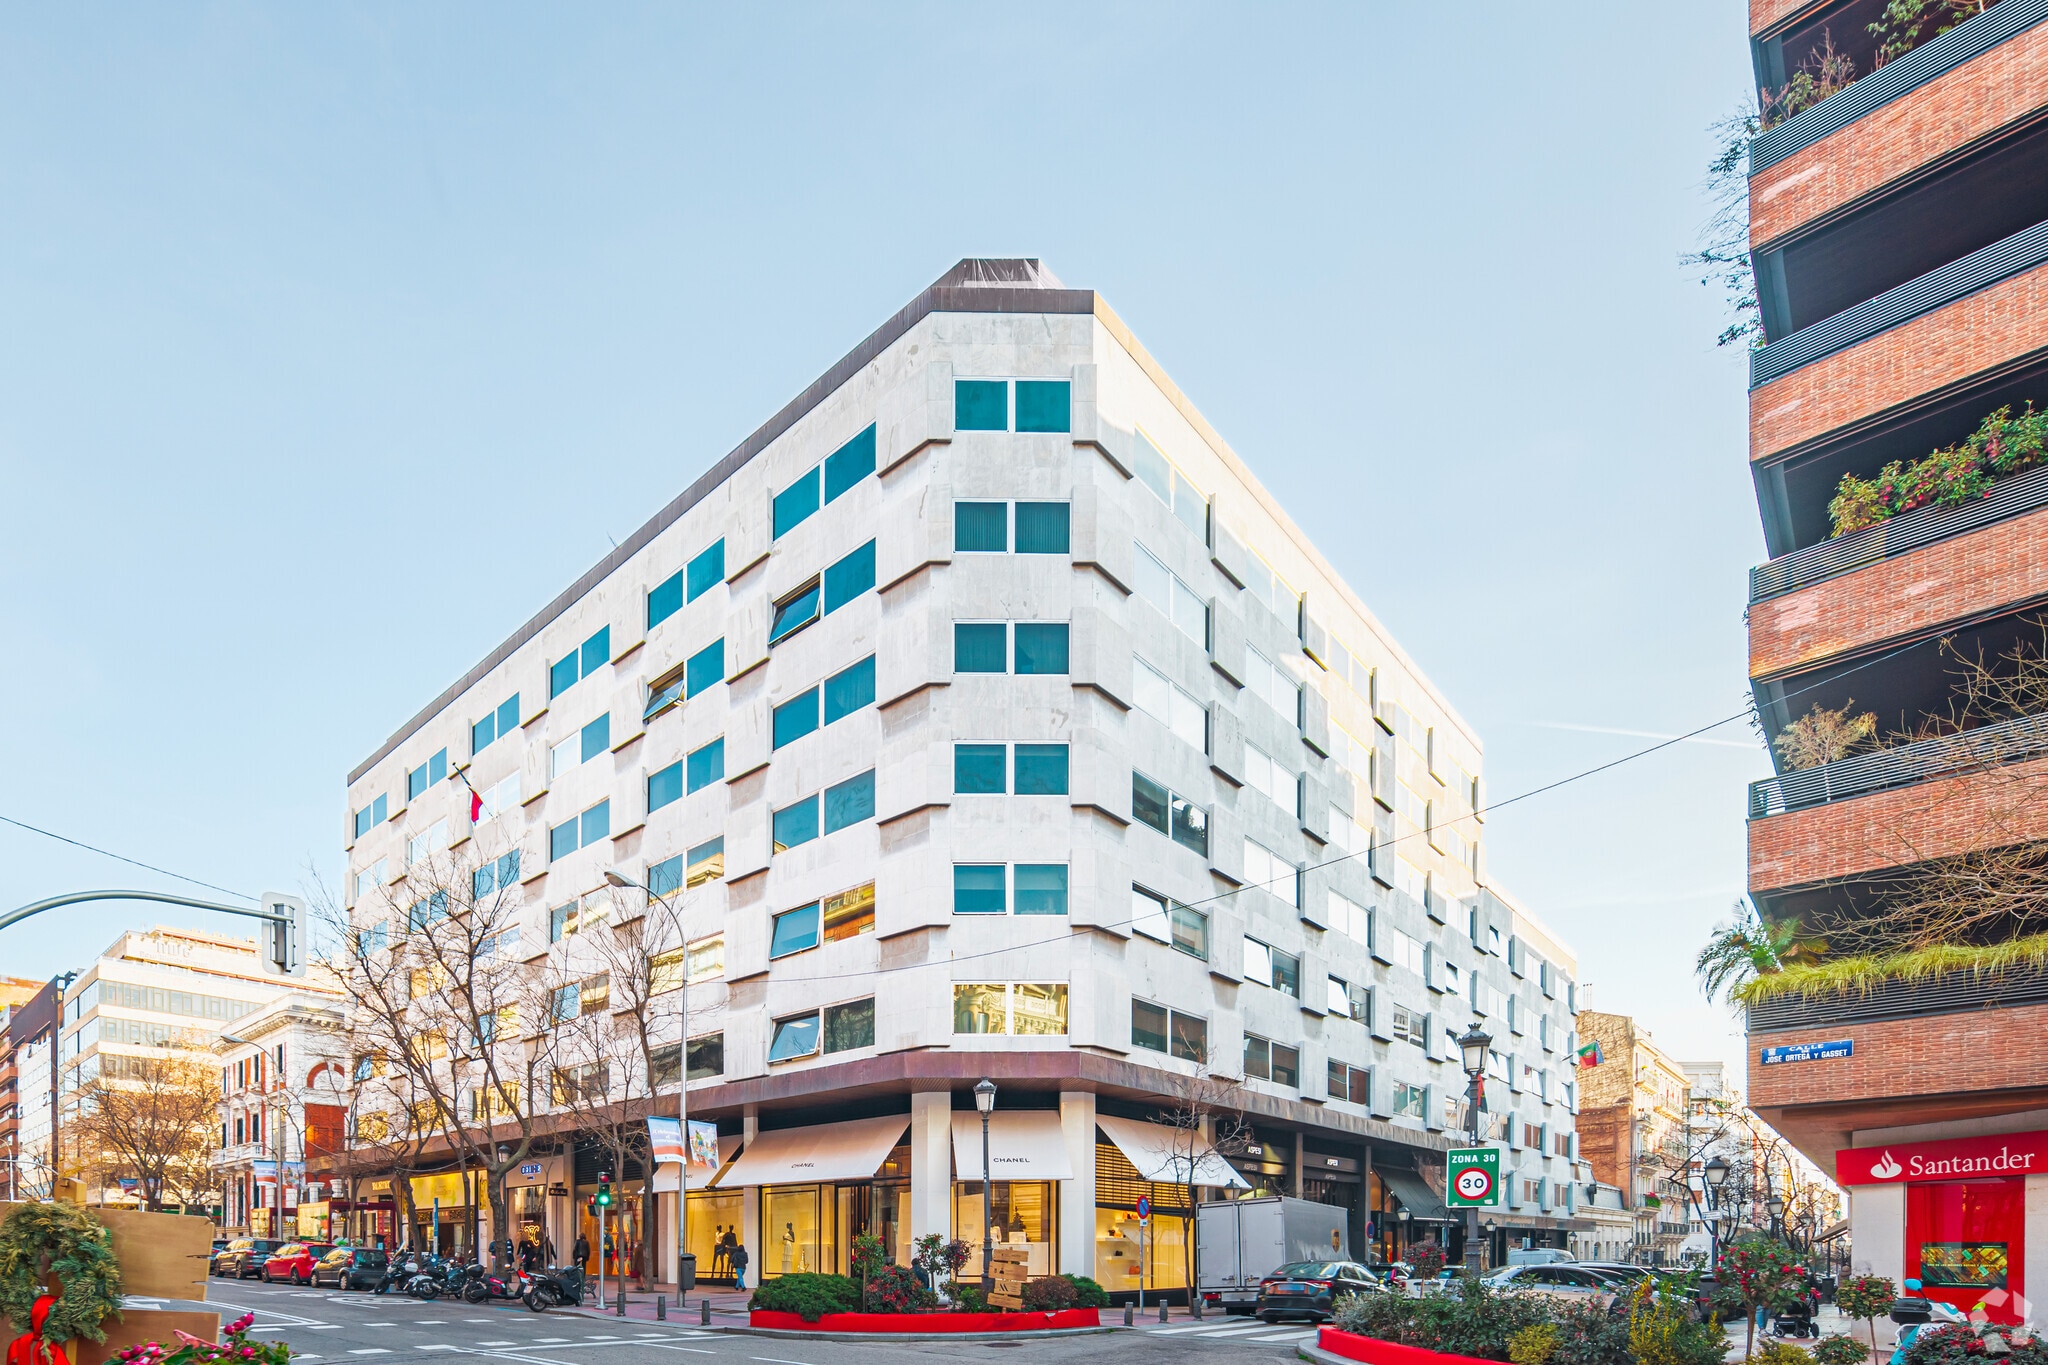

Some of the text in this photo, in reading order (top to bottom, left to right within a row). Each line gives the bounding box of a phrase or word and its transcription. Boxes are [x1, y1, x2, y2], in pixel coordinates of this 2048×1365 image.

[1789, 1043, 1824, 1052] CALLE
[1785, 1053, 1810, 1062] ORTEGA
[1821, 1049, 1848, 1058] GASSET
[1247, 1146, 1262, 1155] ASPESI
[1451, 1154, 1496, 1164] ZONA 30
[1910, 1146, 2035, 1176] Santander
[1462, 1178, 1484, 1189] 30
